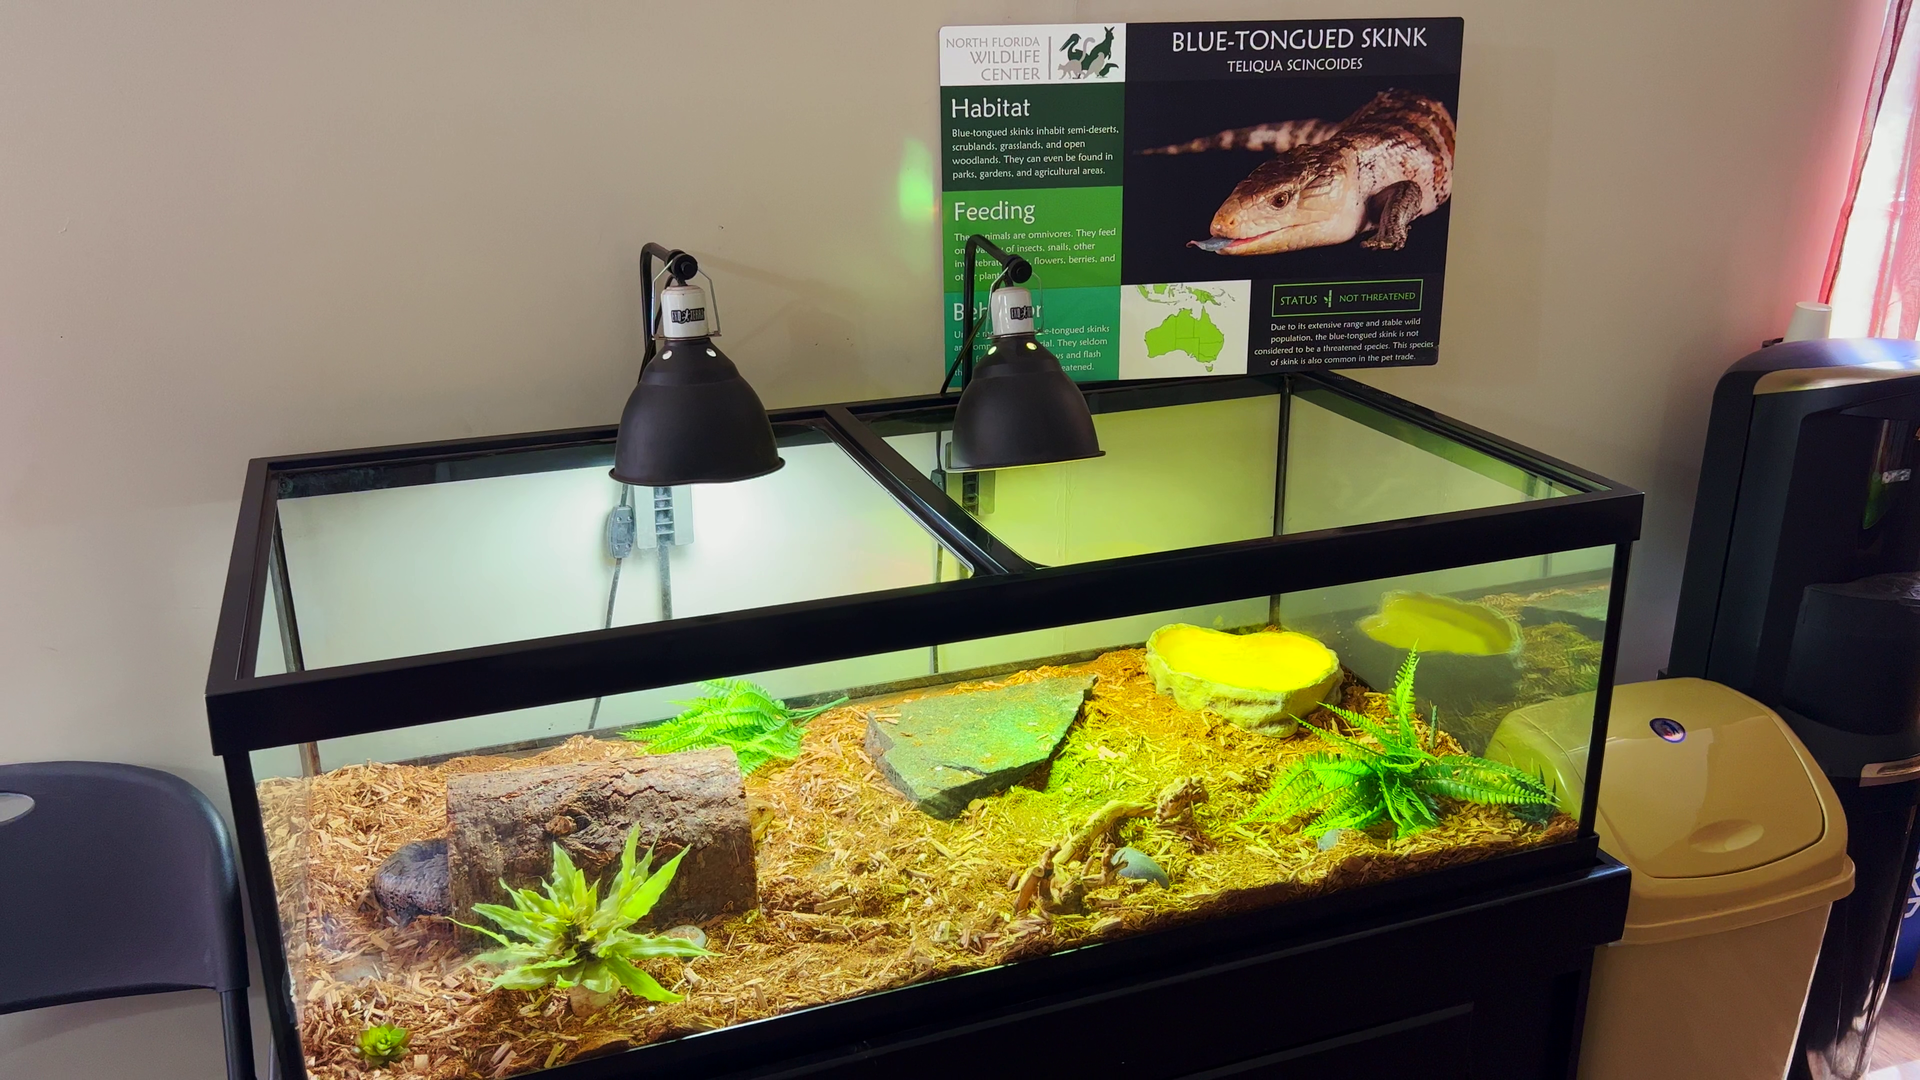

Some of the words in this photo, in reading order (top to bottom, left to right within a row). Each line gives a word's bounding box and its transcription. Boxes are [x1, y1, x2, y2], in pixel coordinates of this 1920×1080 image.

[946, 38, 988, 48] NORTH
[992, 37, 1039, 47] FLORIDA
[1173, 29, 1354, 52] BLUE-TONGUED
[1361, 27, 1428, 48] SKINK
[970, 50, 1040, 64] WILDLIFE
[1227, 59, 1283, 74] TELIQUA
[1287, 57, 1363, 71] SCINCOIDES
[981, 68, 1040, 81] CENTER
[951, 98, 1031, 118] Habitat
[952, 128, 1007, 138] Blue-tongued
[1010, 127, 1034, 136] skinks
[1037, 126, 1065, 135] inhabit
[952, 142, 997, 151] scrublands,
[1000, 141, 1043, 151] grasslands,
[1046, 140, 1062, 149] and
[1064, 141, 1085, 150] open
[952, 156, 1001, 165] woodlands.
[1004, 155, 1024, 165] They
[1066, 153, 1076, 162] be
[1078, 152, 1103, 161] found
[1105, 152, 1113, 160] in
[1017, 168, 1032, 177] and
[1035, 167, 1079, 177] agricultural
[1082, 167, 1105, 175] areas.
[954, 201, 1035, 224] Feeding
[1076, 229, 1097, 238] They
[1098, 228, 1116, 236] feed
[1006, 244, 1015, 252] of
[1017, 244, 1045, 252] insects,
[1048, 242, 1070, 251] snails,
[1074, 242, 1095, 251] other
[1069, 255, 1097, 264] berries,
[1100, 254, 1115, 262] and
[1280, 295, 1318, 306] STATUS
[1339, 294, 1358, 303] NOT
[1361, 292, 1415, 301] THREATENED
[1087, 324, 1110, 333] skinks
[1271, 323, 1286, 331] Due
[1288, 322, 1296, 331] to
[1298, 322, 1306, 330] its
[1308, 320, 1342, 330] extensive
[1344, 320, 1364, 330] range
[1366, 318, 1380, 327] and
[1382, 318, 1402, 326] stable
[1405, 317, 1420, 325] wild
[1058, 339, 1078, 348] They
[1080, 338, 1108, 346] seldom
[1271, 334, 1312, 344] population,
[1315, 333, 1327, 341] the
[1329, 331, 1377, 341] blue-tongued
[1379, 330, 1397, 338] skink
[1406, 329, 1419, 337] not
[1254, 345, 1294, 355] considered
[1295, 345, 1304, 353] to
[1305, 345, 1314, 353] be
[1323, 343, 1362, 352] threatened
[1364, 342, 1390, 352] species.
[1393, 341, 1407, 349] This
[1410, 340, 1434, 350] species
[1066, 351, 1081, 359] and
[1083, 350, 1101, 358] flash
[1270, 357, 1279, 366] of
[1280, 356, 1299, 365] skink
[1301, 357, 1306, 365] is
[1308, 355, 1322, 364] also
[1324, 355, 1356, 363] common
[1359, 354, 1365, 362] in
[1368, 353, 1379, 361] the
[1381, 353, 1393, 363] pet
[1395, 352, 1416, 361] trade.
